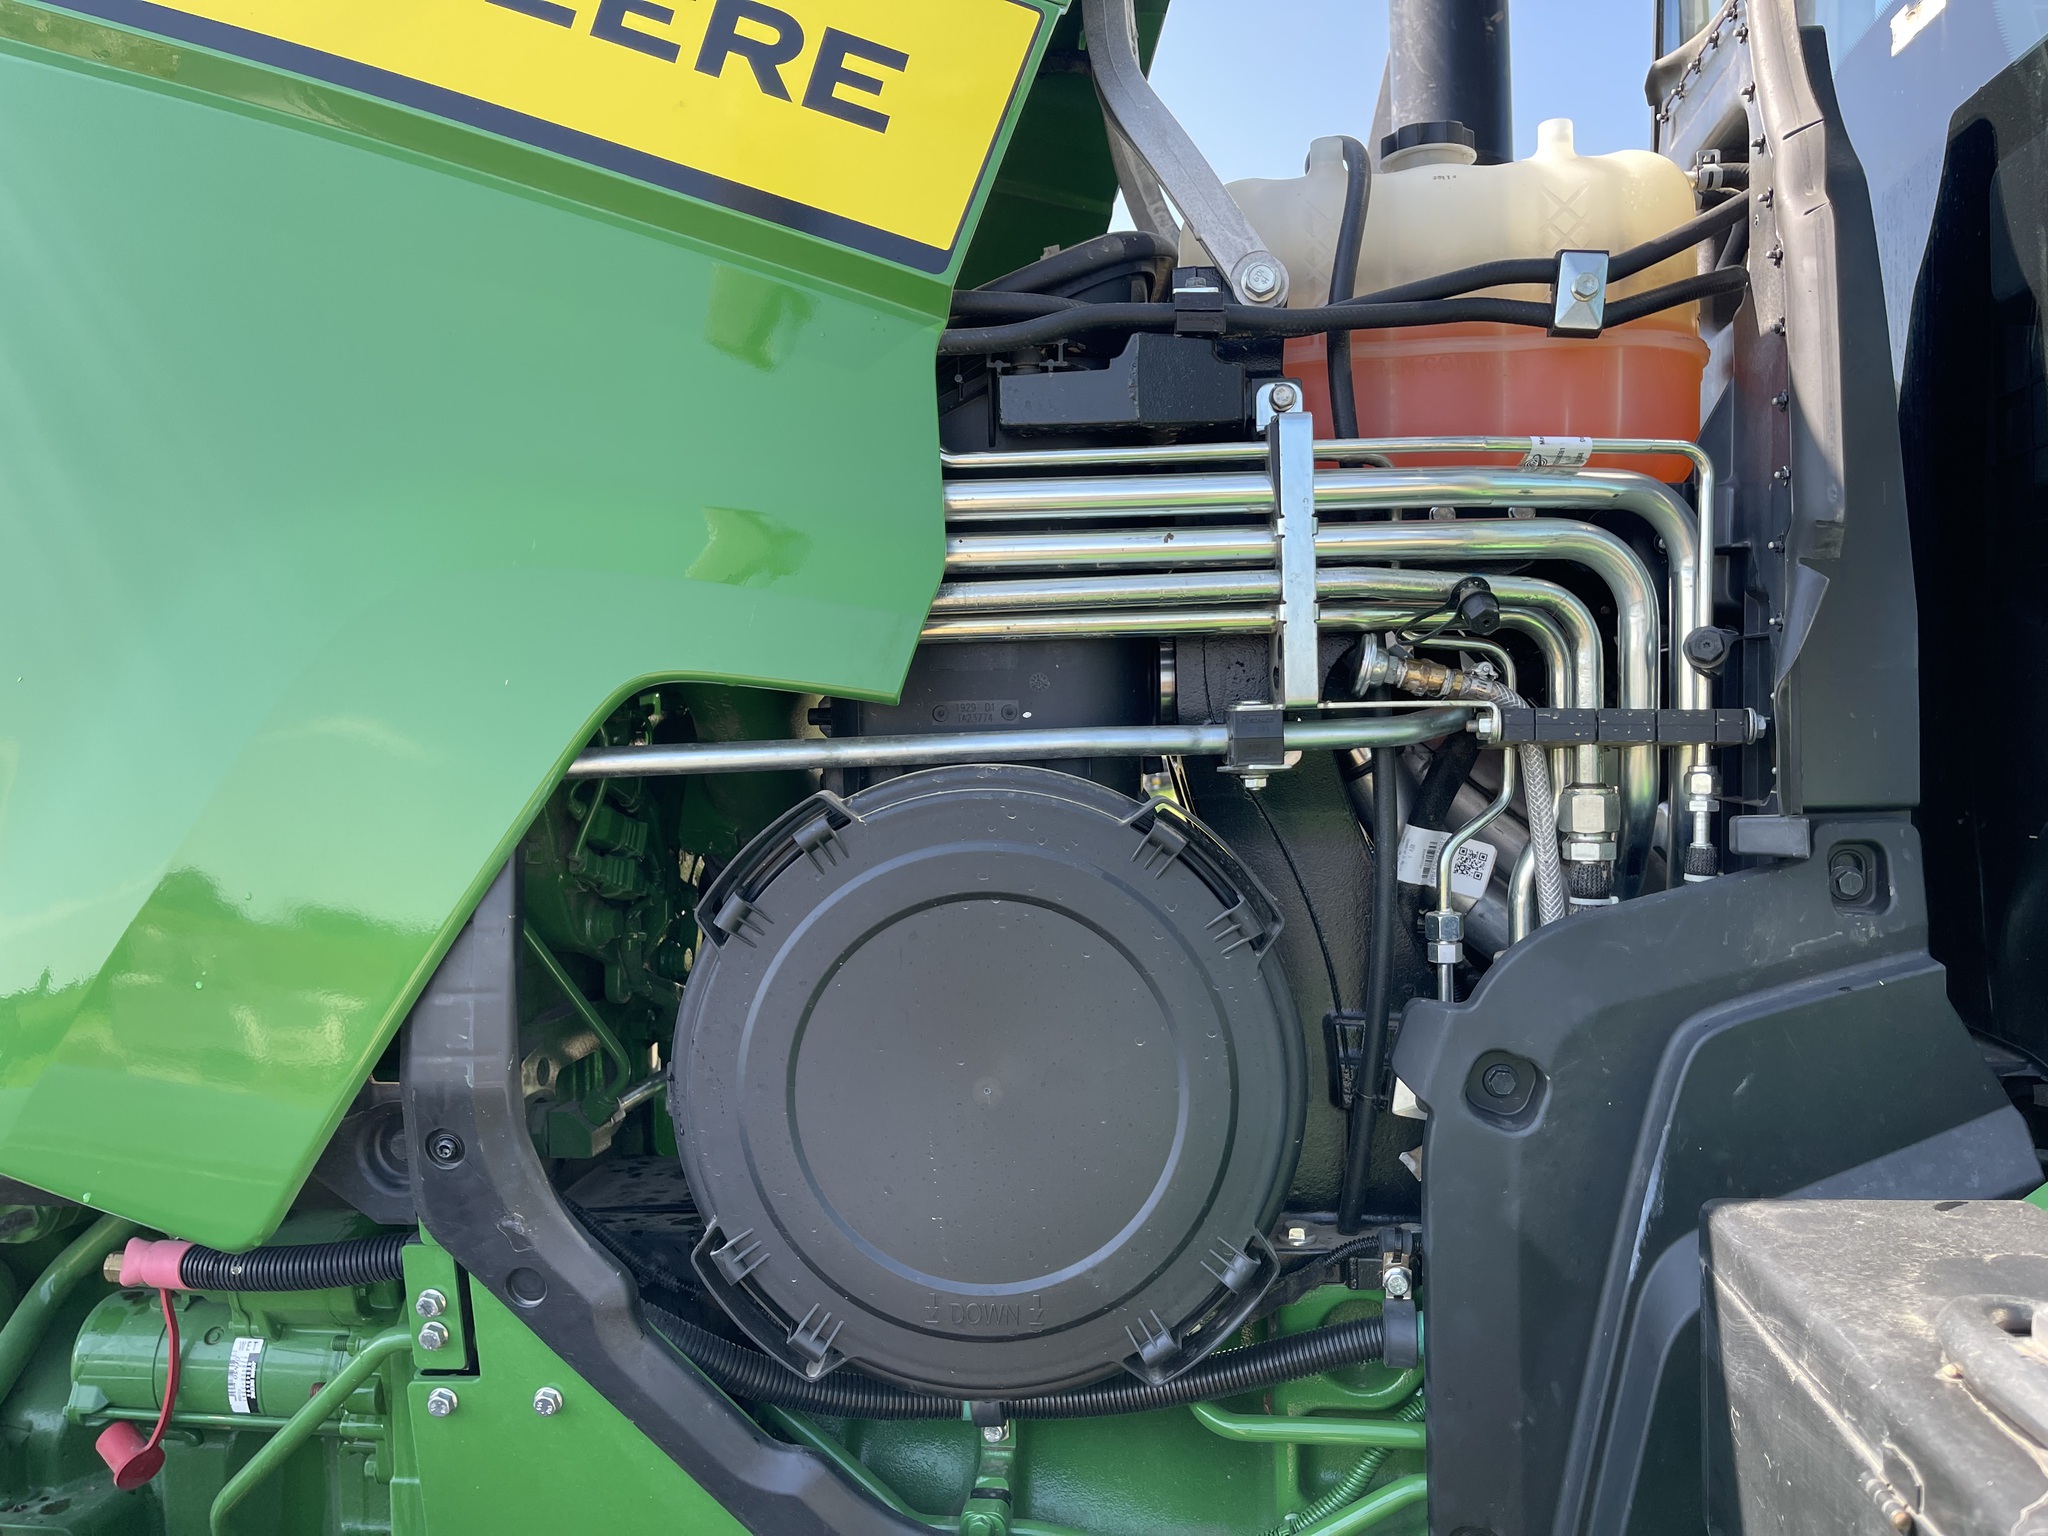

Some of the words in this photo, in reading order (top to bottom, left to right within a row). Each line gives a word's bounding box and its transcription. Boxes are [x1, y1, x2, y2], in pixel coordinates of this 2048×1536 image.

[485, 0, 910, 134] ERE
[950, 1302, 1020, 1326] DOWN
[238, 1340, 259, 1352] WET
